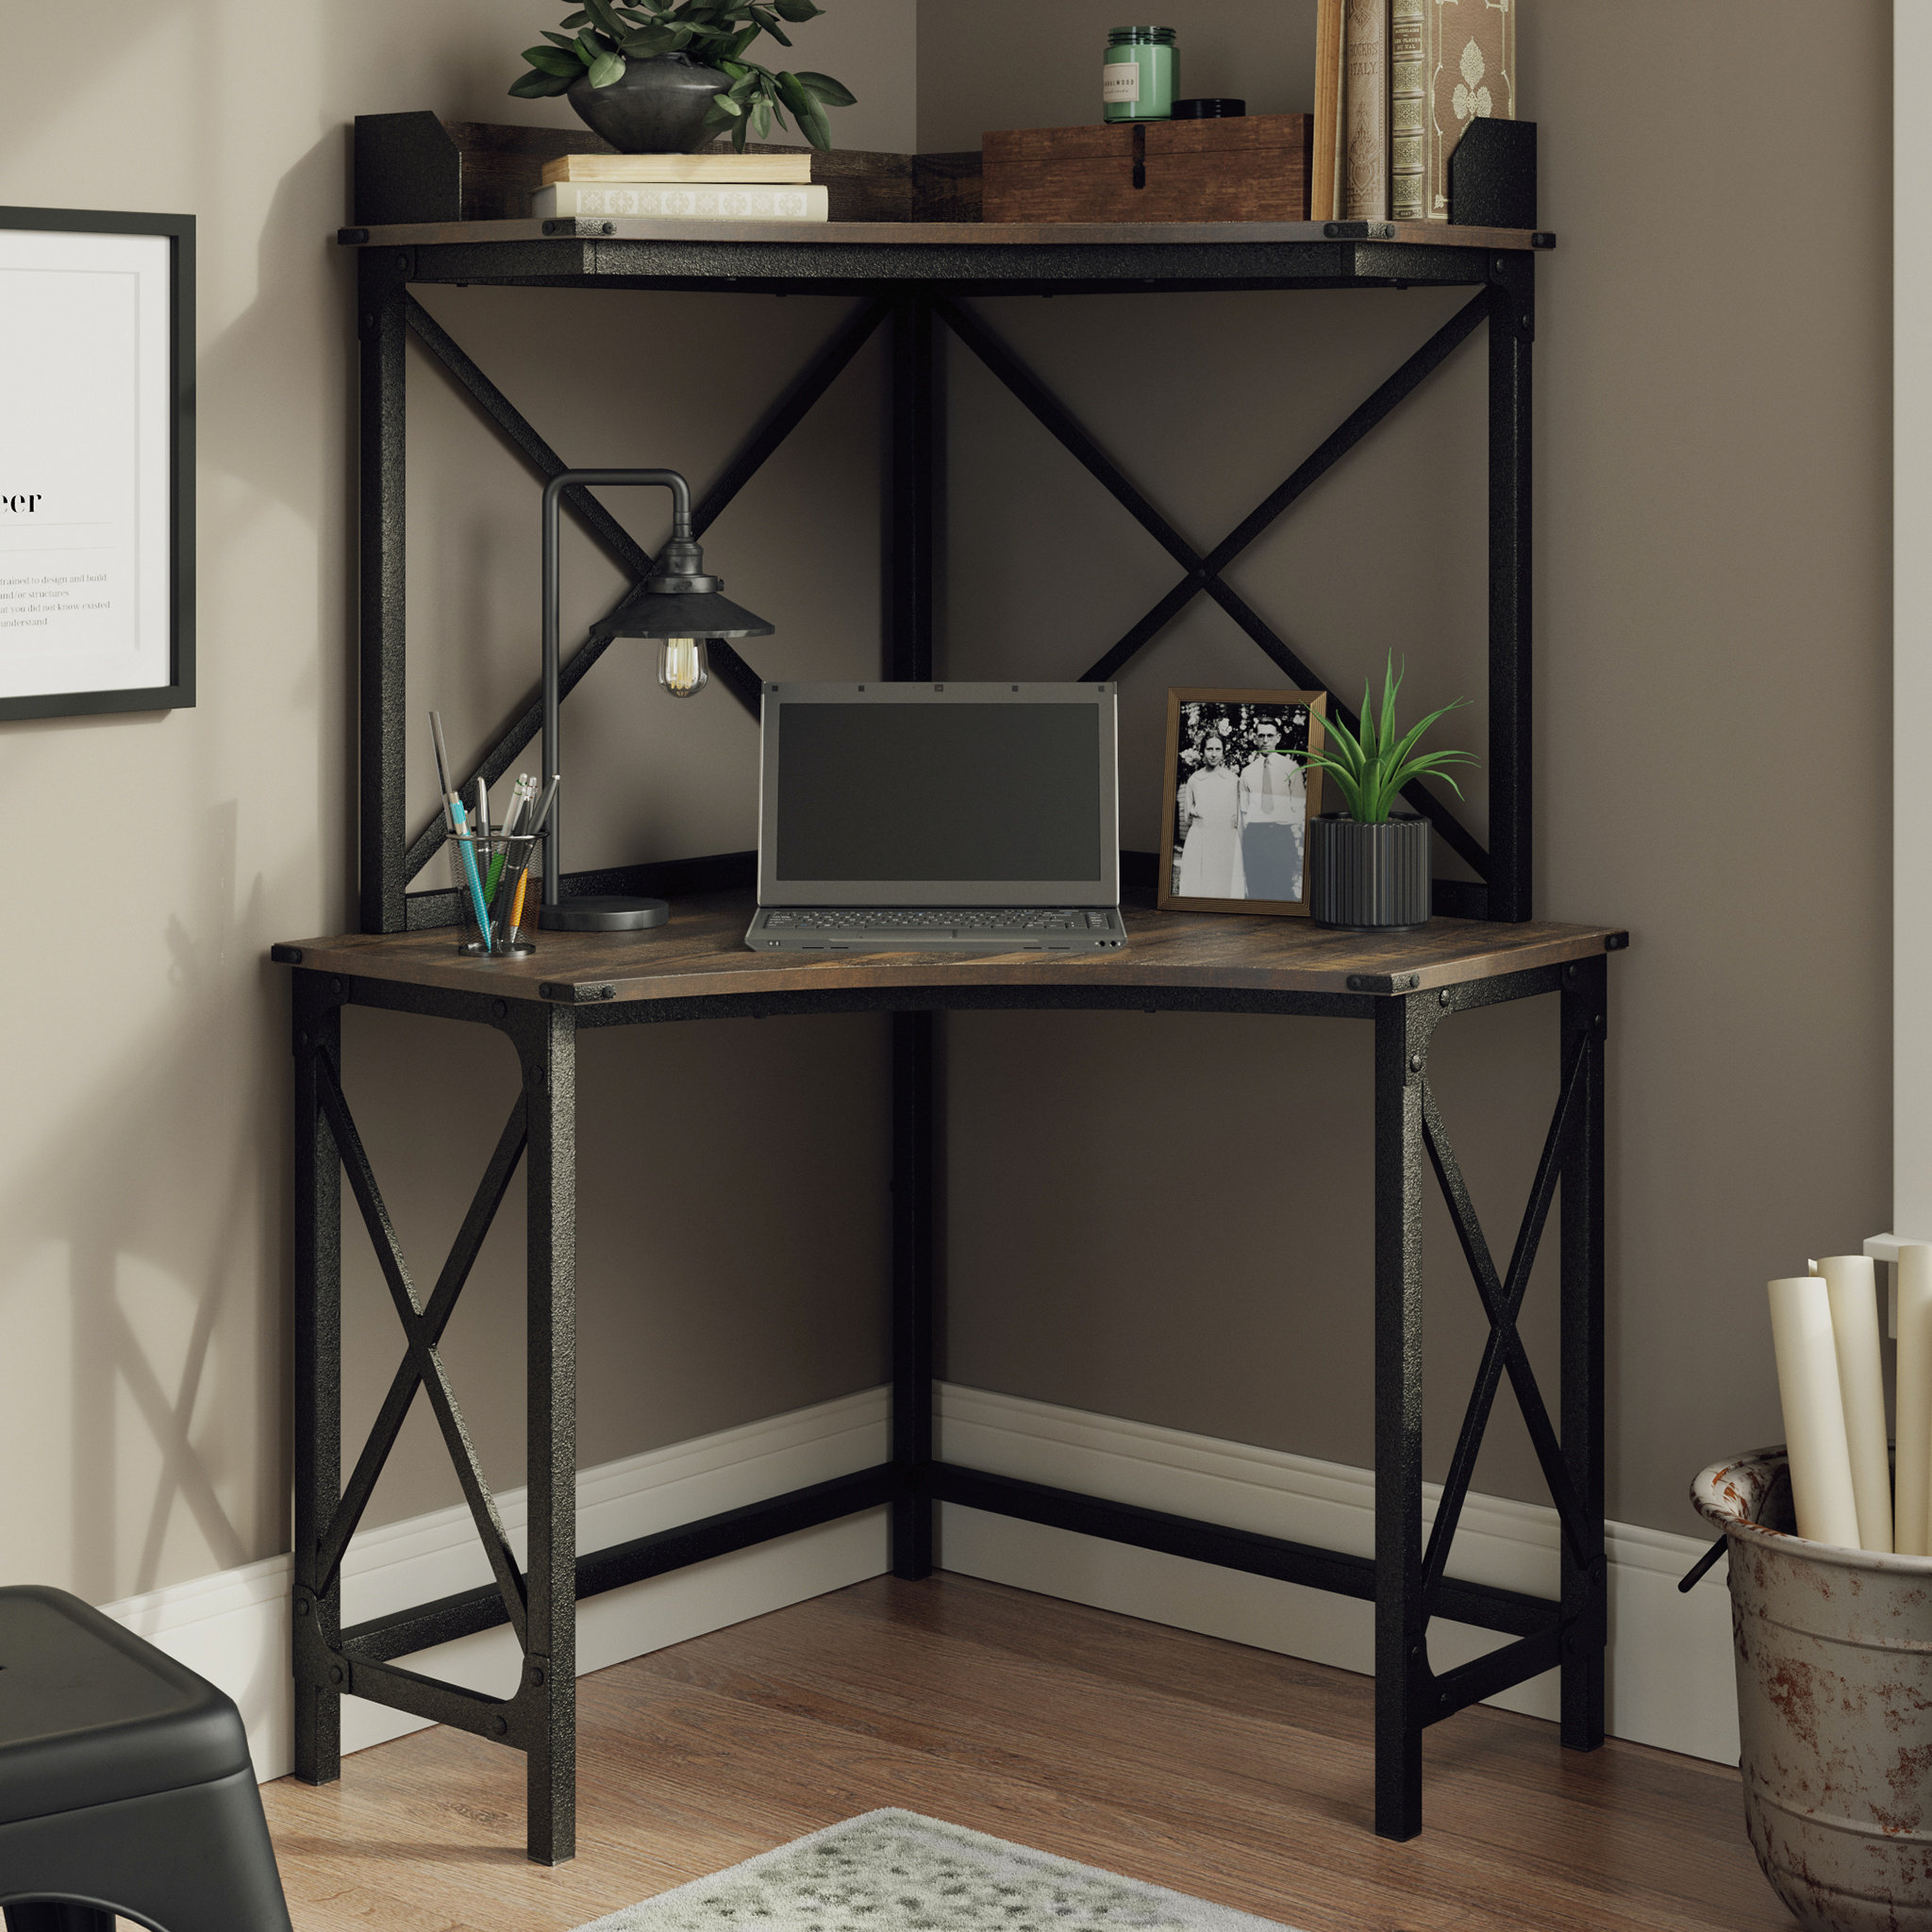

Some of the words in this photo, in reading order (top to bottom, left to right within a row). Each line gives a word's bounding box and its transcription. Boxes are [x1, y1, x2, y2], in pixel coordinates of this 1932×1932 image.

[41, 575, 68, 586] design
[69, 574, 85, 583] and
[86, 573, 108, 582] build
[28, 590, 70, 599] structures
[10, 606, 25, 614] you
[27, 603, 42, 612] did
[42, 604, 57, 612] not
[58, 602, 80, 611] know
[82, 600, 111, 609] existed
